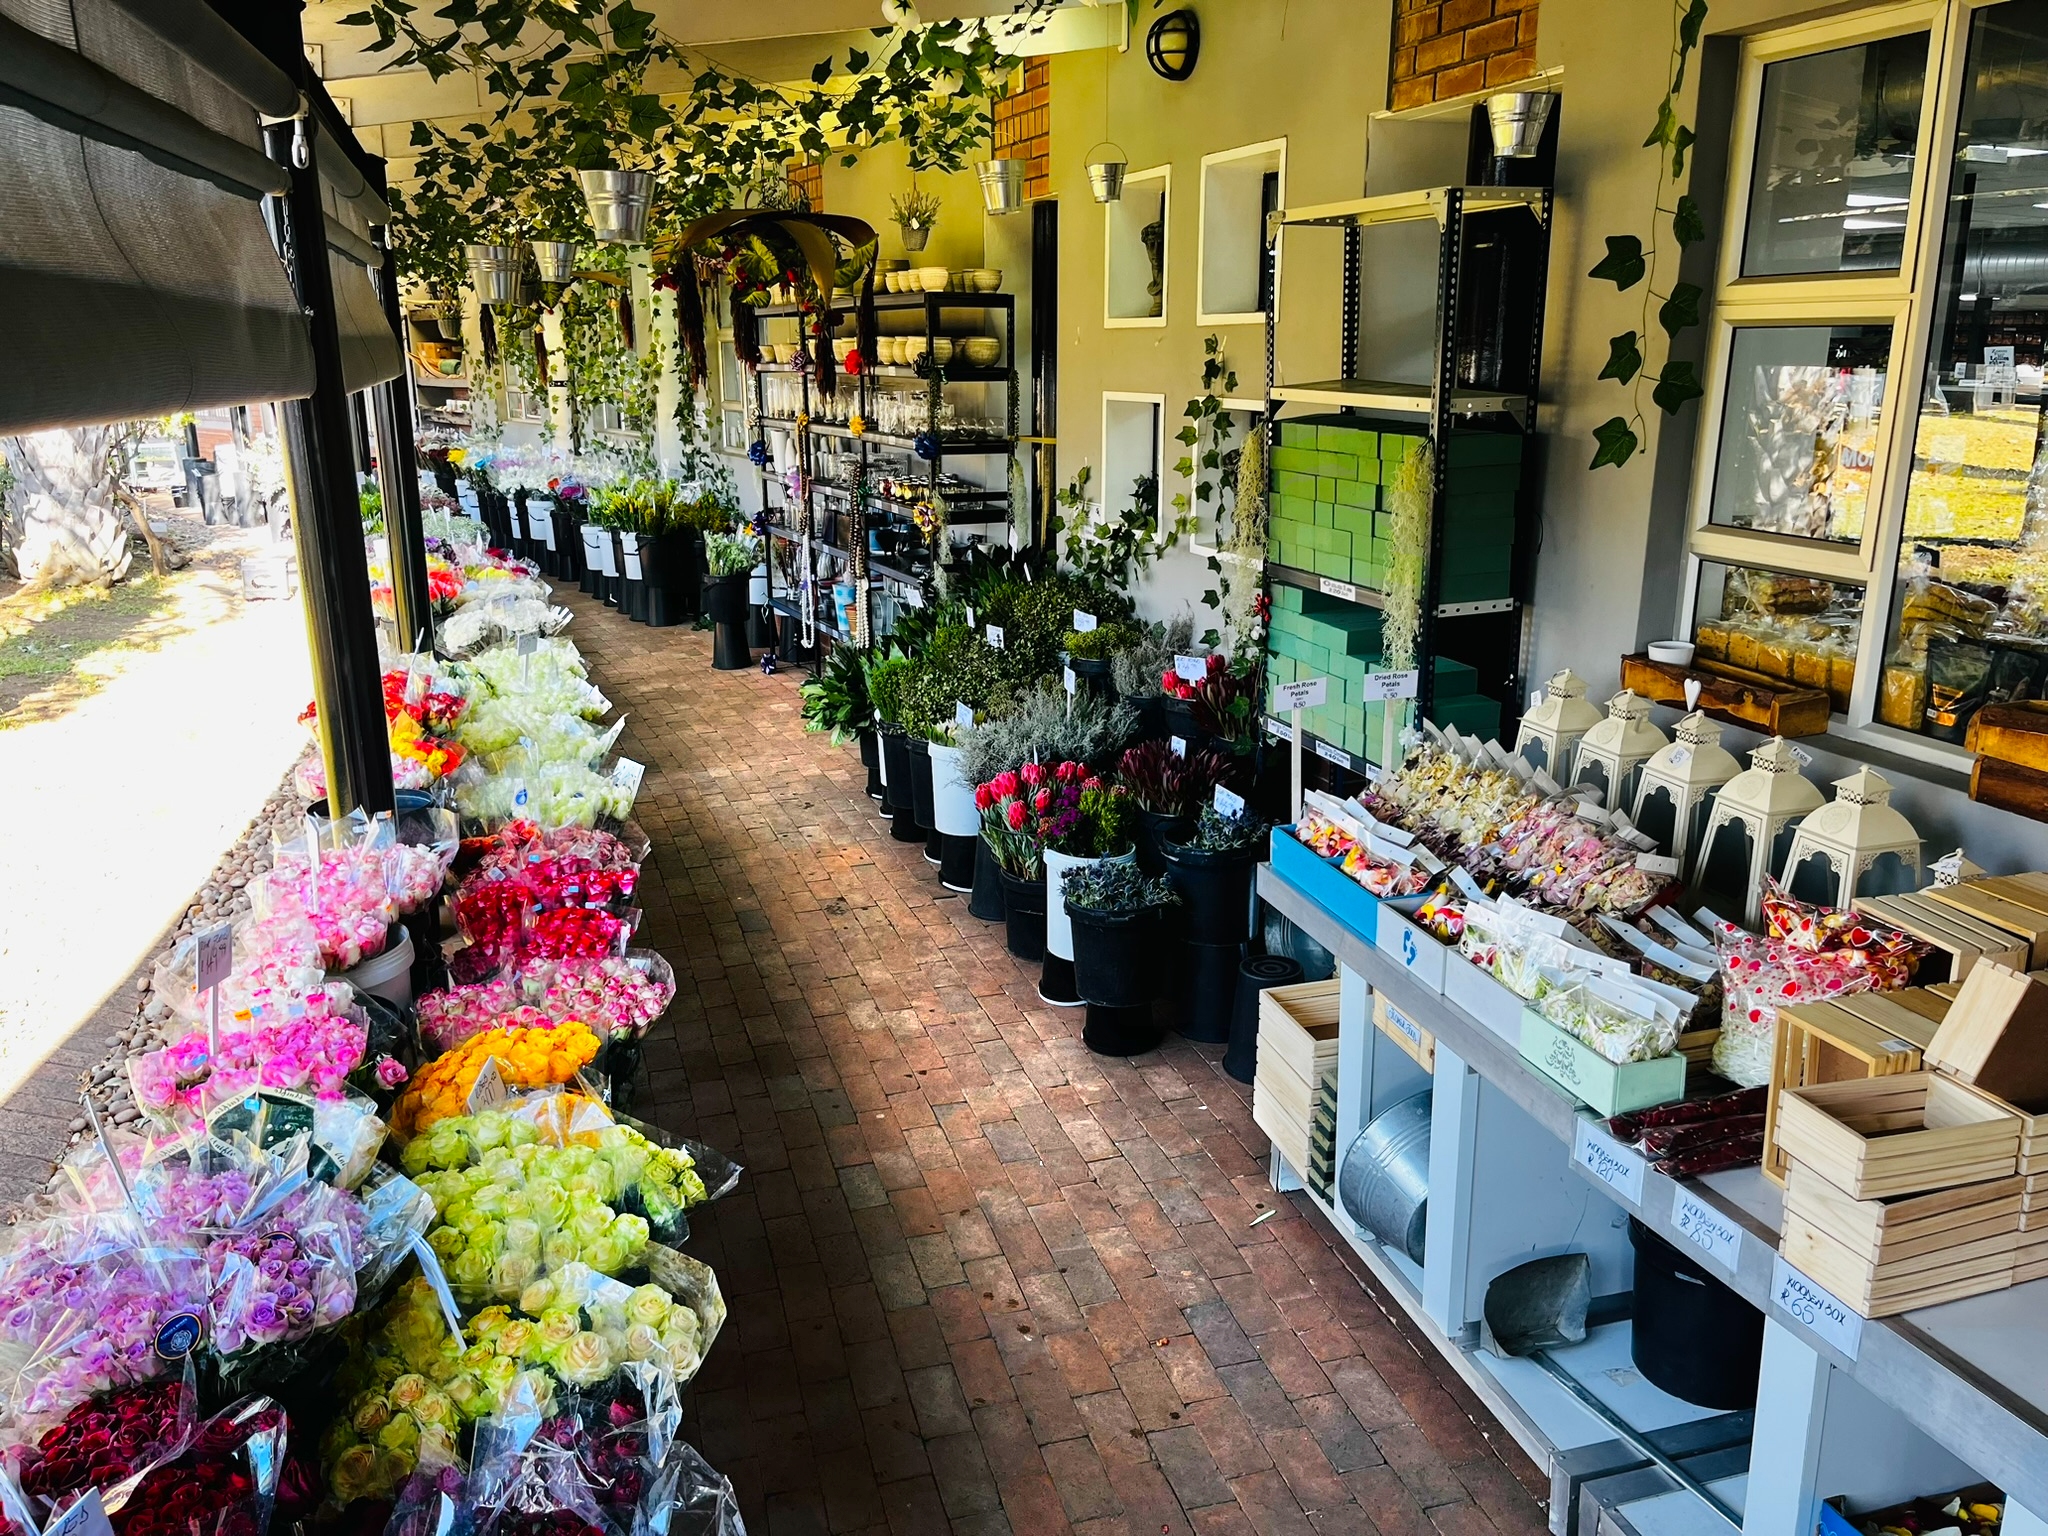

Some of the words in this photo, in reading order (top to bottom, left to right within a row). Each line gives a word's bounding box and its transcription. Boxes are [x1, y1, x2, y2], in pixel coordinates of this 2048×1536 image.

[1282, 683, 1301, 691] Fresh
[1290, 690, 1309, 698] Petals
[1586, 1139, 1614, 1167] WOODEN
[1613, 1161, 1630, 1178] BOX
[1682, 1196, 1717, 1231] WOODEN
[1715, 1226, 1735, 1245] BOX
[1786, 1274, 1824, 1310] WOODEN
[1825, 1303, 1847, 1327] BOX
